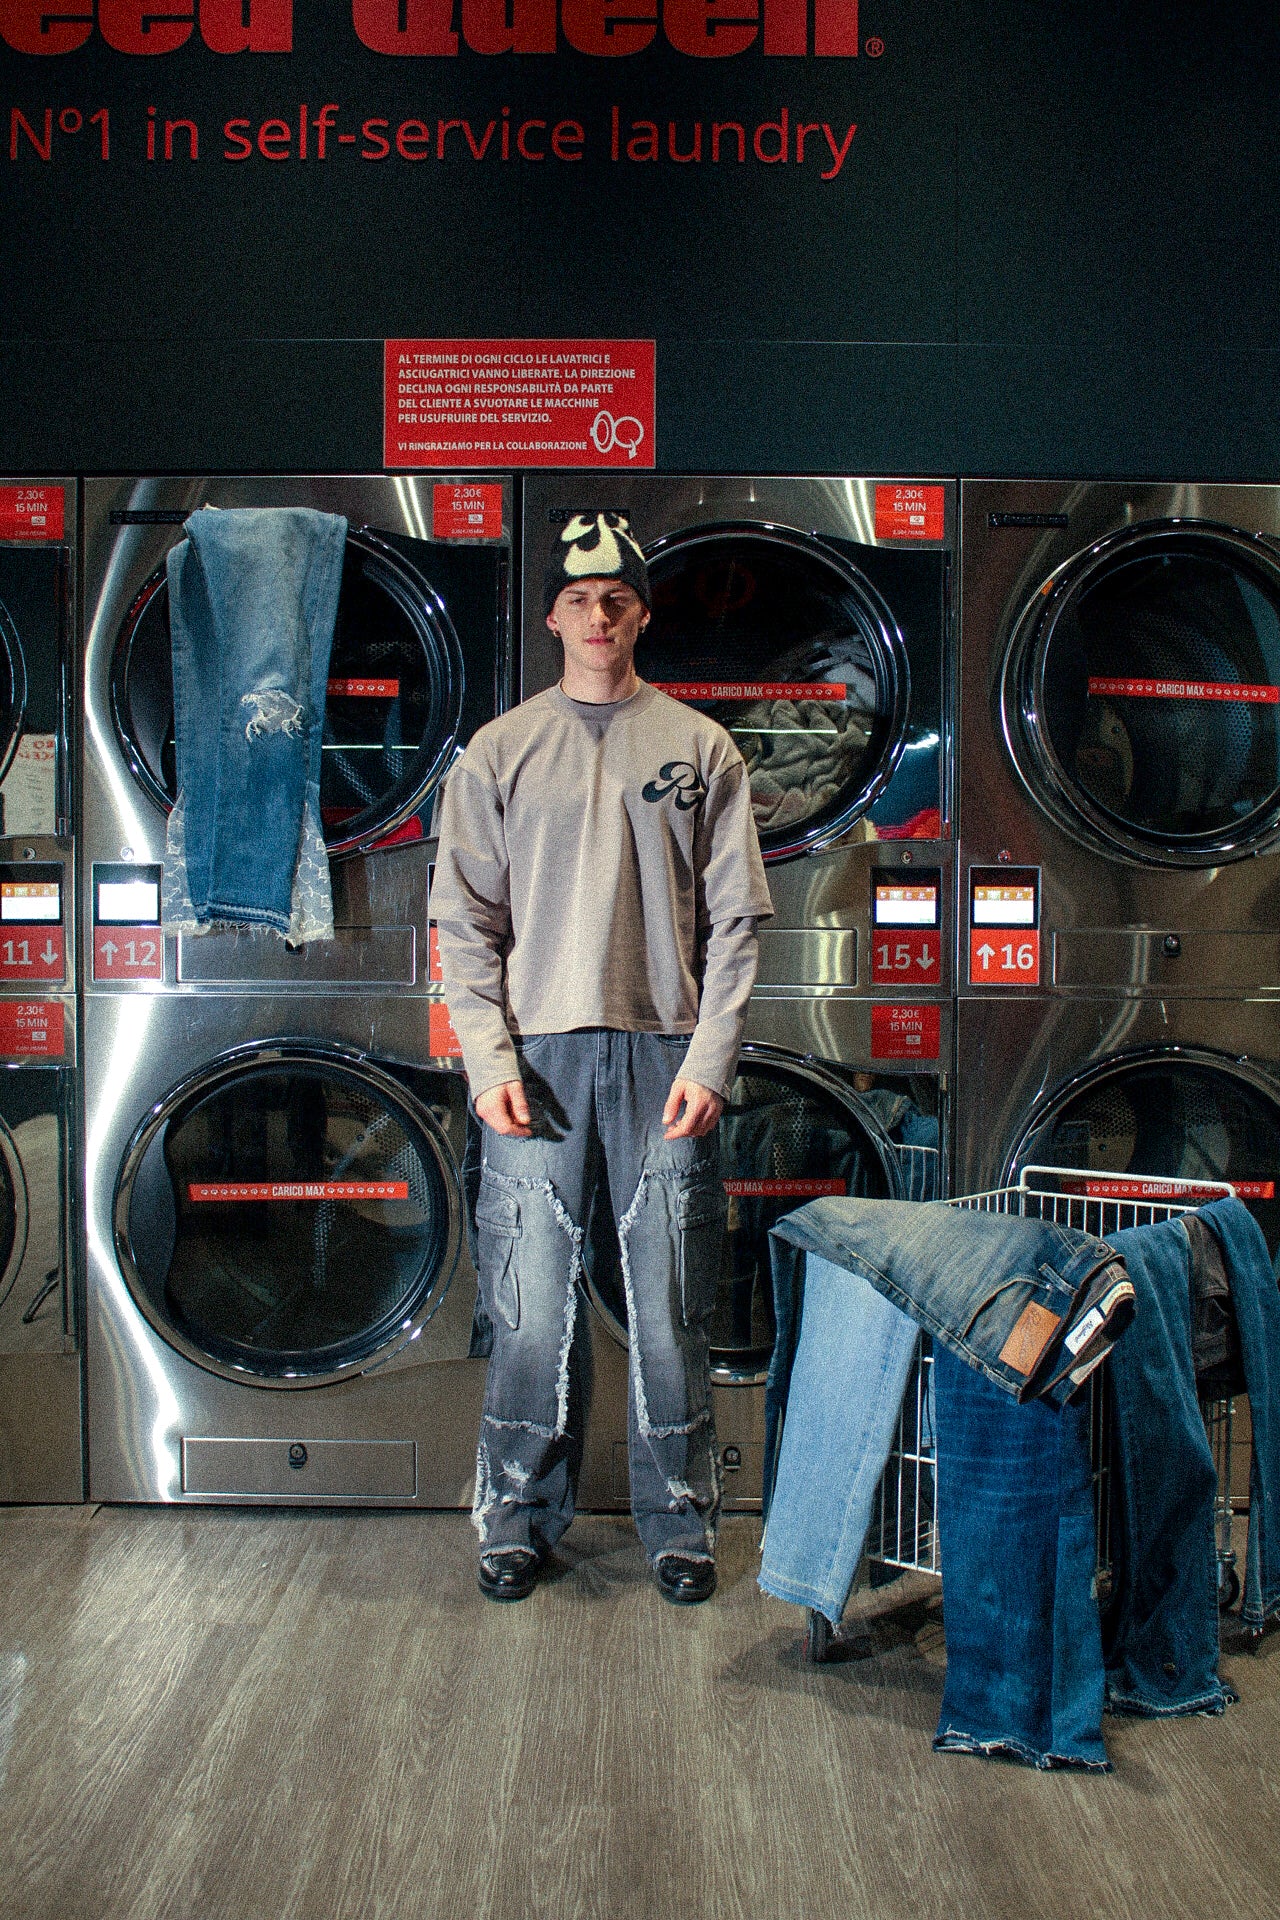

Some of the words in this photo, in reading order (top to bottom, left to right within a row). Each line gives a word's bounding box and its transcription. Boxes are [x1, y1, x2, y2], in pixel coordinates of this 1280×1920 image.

[147, 105, 198, 160] in
[224, 104, 585, 161] self-service
[611, 105, 858, 180] laundry
[398, 354, 412, 364] AL
[413, 354, 459, 364] TERMINE
[461, 354, 473, 364] DI
[474, 354, 502, 364] OGNI
[503, 354, 534, 364] CICLO
[535, 354, 548, 364] LE
[549, 354, 602, 364] LAVATRICI
[604, 354, 610, 364] E
[398, 368, 470, 379] ASCIUGATRICI
[471, 368, 510, 379] VANNO
[511, 368, 563, 379] LIBERATE.
[564, 368, 578, 379] LA
[580, 368, 636, 379] DIREZIONE
[398, 383, 443, 394] DECLINA
[444, 383, 472, 394] OGNI
[473, 381, 562, 394] RESPONSABILITÀ
[563, 383, 579, 394] DA
[580, 383, 614, 394] PARTE
[398, 398, 418, 408] DEL
[419, 398, 462, 408] CLIENTE
[463, 398, 472, 408] A
[473, 398, 529, 408] SVUOTARE
[530, 398, 543, 408] LE
[544, 398, 599, 408] MACCHINE
[398, 413, 418, 423] PER
[419, 413, 478, 423] USUFRUIRE
[479, 413, 500, 423] DEL
[501, 413, 552, 423] SERVIZIO.
[397, 441, 407, 450] VI
[408, 441, 473, 450] RINGRAZIAMO
[474, 441, 492, 450] PER
[492, 441, 505, 450] LA
[505, 441, 587, 450] COLLABORAZIONE
[15, 503, 26, 513] 15
[26, 503, 48, 512] MIN
[451, 501, 462, 511] 15
[463, 501, 485, 510] MIN
[893, 502, 904, 512] 15
[905, 502, 927, 512] MIN
[711, 684, 742, 698] CARICO
[743, 684, 764, 698] MAX
[1155, 683, 1186, 696] CARICO
[1186, 684, 1205, 696] MAX
[2, 940, 33, 966] 11
[124, 940, 157, 967] 12
[877, 944, 911, 970] 15
[1001, 943, 1034, 970] 16
[15, 1018, 27, 1028] 15
[27, 1018, 49, 1028] MIN
[890, 1022, 900, 1031] 15
[901, 1022, 923, 1031] MIN
[272, 1185, 304, 1197] CARICO
[305, 1185, 326, 1196] MAX
[743, 1182, 764, 1192] MAX
[1141, 1183, 1172, 1195] CARICO
[1173, 1183, 1193, 1195] MAX
